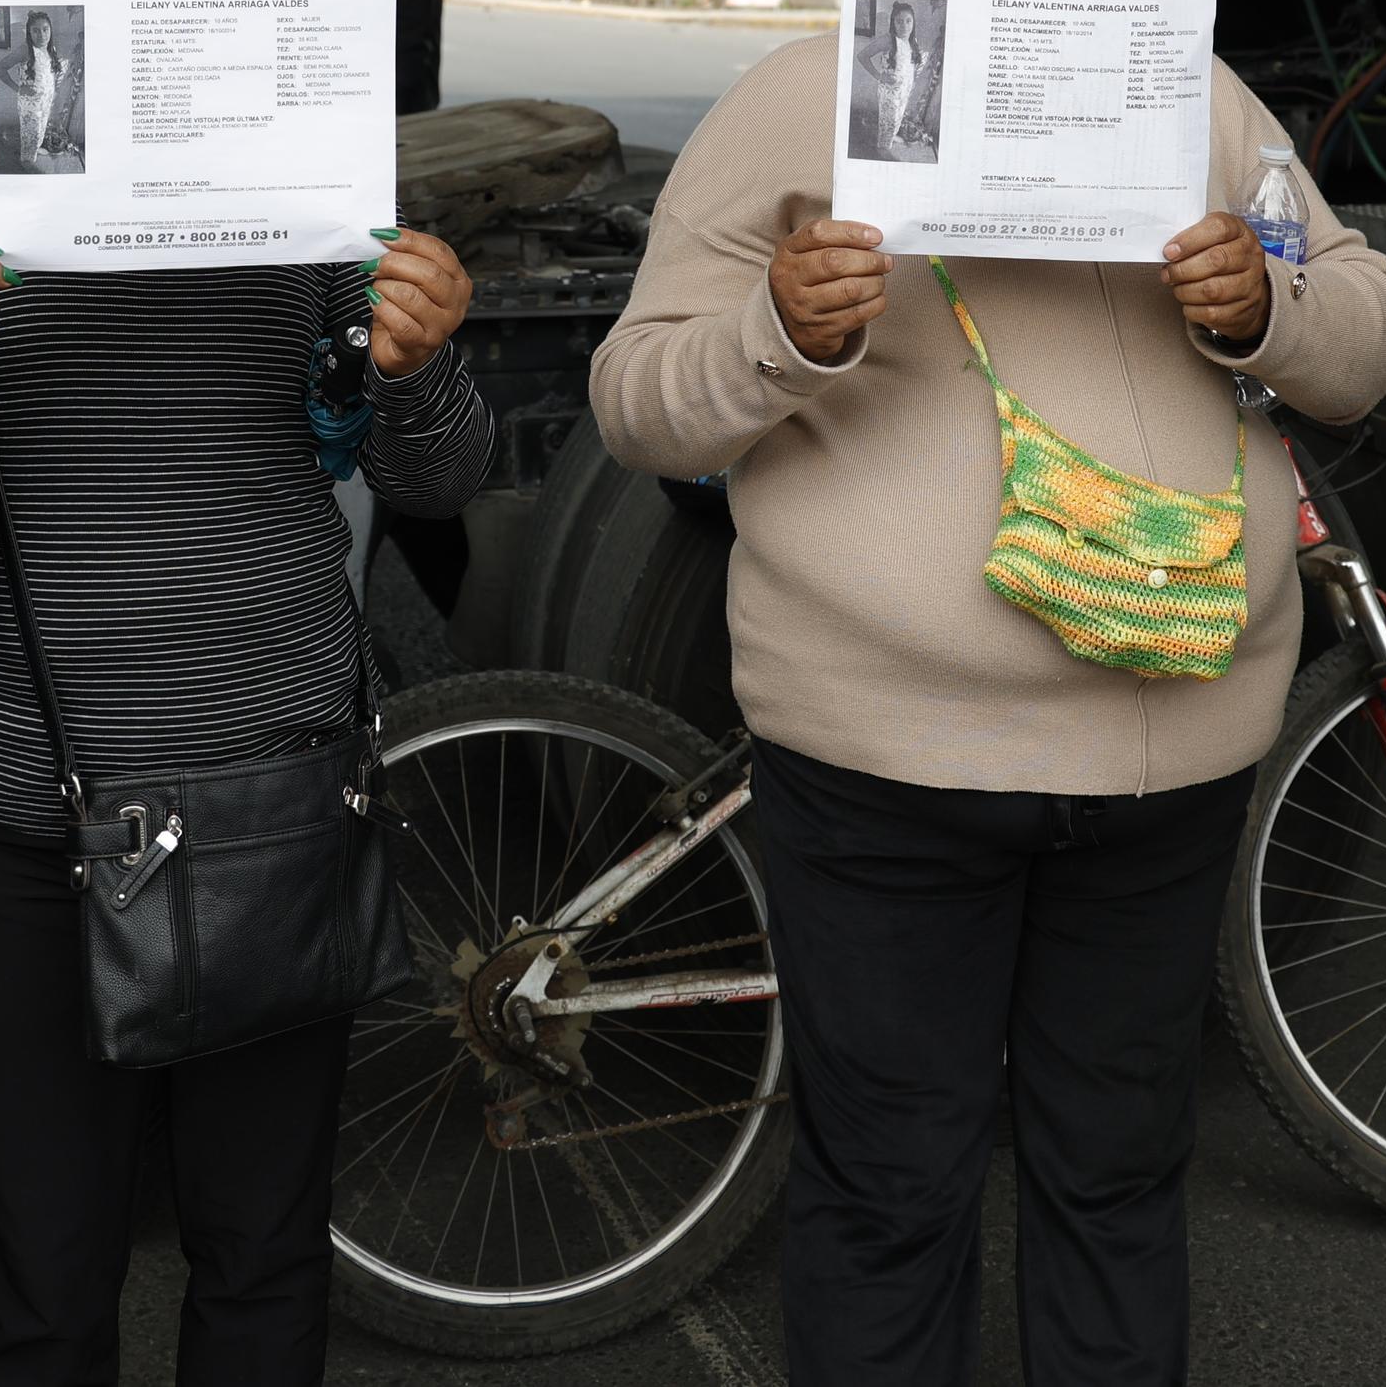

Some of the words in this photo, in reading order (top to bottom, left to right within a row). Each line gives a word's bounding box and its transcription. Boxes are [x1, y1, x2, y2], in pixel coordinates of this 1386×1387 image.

[131, 1, 170, 9] LEILANY
[173, 1, 225, 9] VALENTINA
[228, 0, 270, 8] ARRIAGA
[1033, 1, 1084, 12] VALENTINA
[1086, 4, 1126, 13] ARRIAGA
[1128, 4, 1160, 12] VALDES
[921, 222, 947, 232] 800
[952, 223, 976, 233] 509
[980, 223, 996, 234] 09
[999, 224, 1016, 234] 27
[1030, 225, 1056, 236] 800
[1059, 226, 1085, 237] 216
[1088, 227, 1106, 237] 03
[1109, 227, 1124, 238] 61
[74, 235, 100, 245] 800
[104, 234, 131, 244] 509
[136, 233, 153, 243] 09
[157, 233, 174, 243] 27
[190, 232, 216, 242] 800
[220, 231, 246, 241] 216
[251, 230, 268, 240] 03
[272, 230, 288, 240] 61
